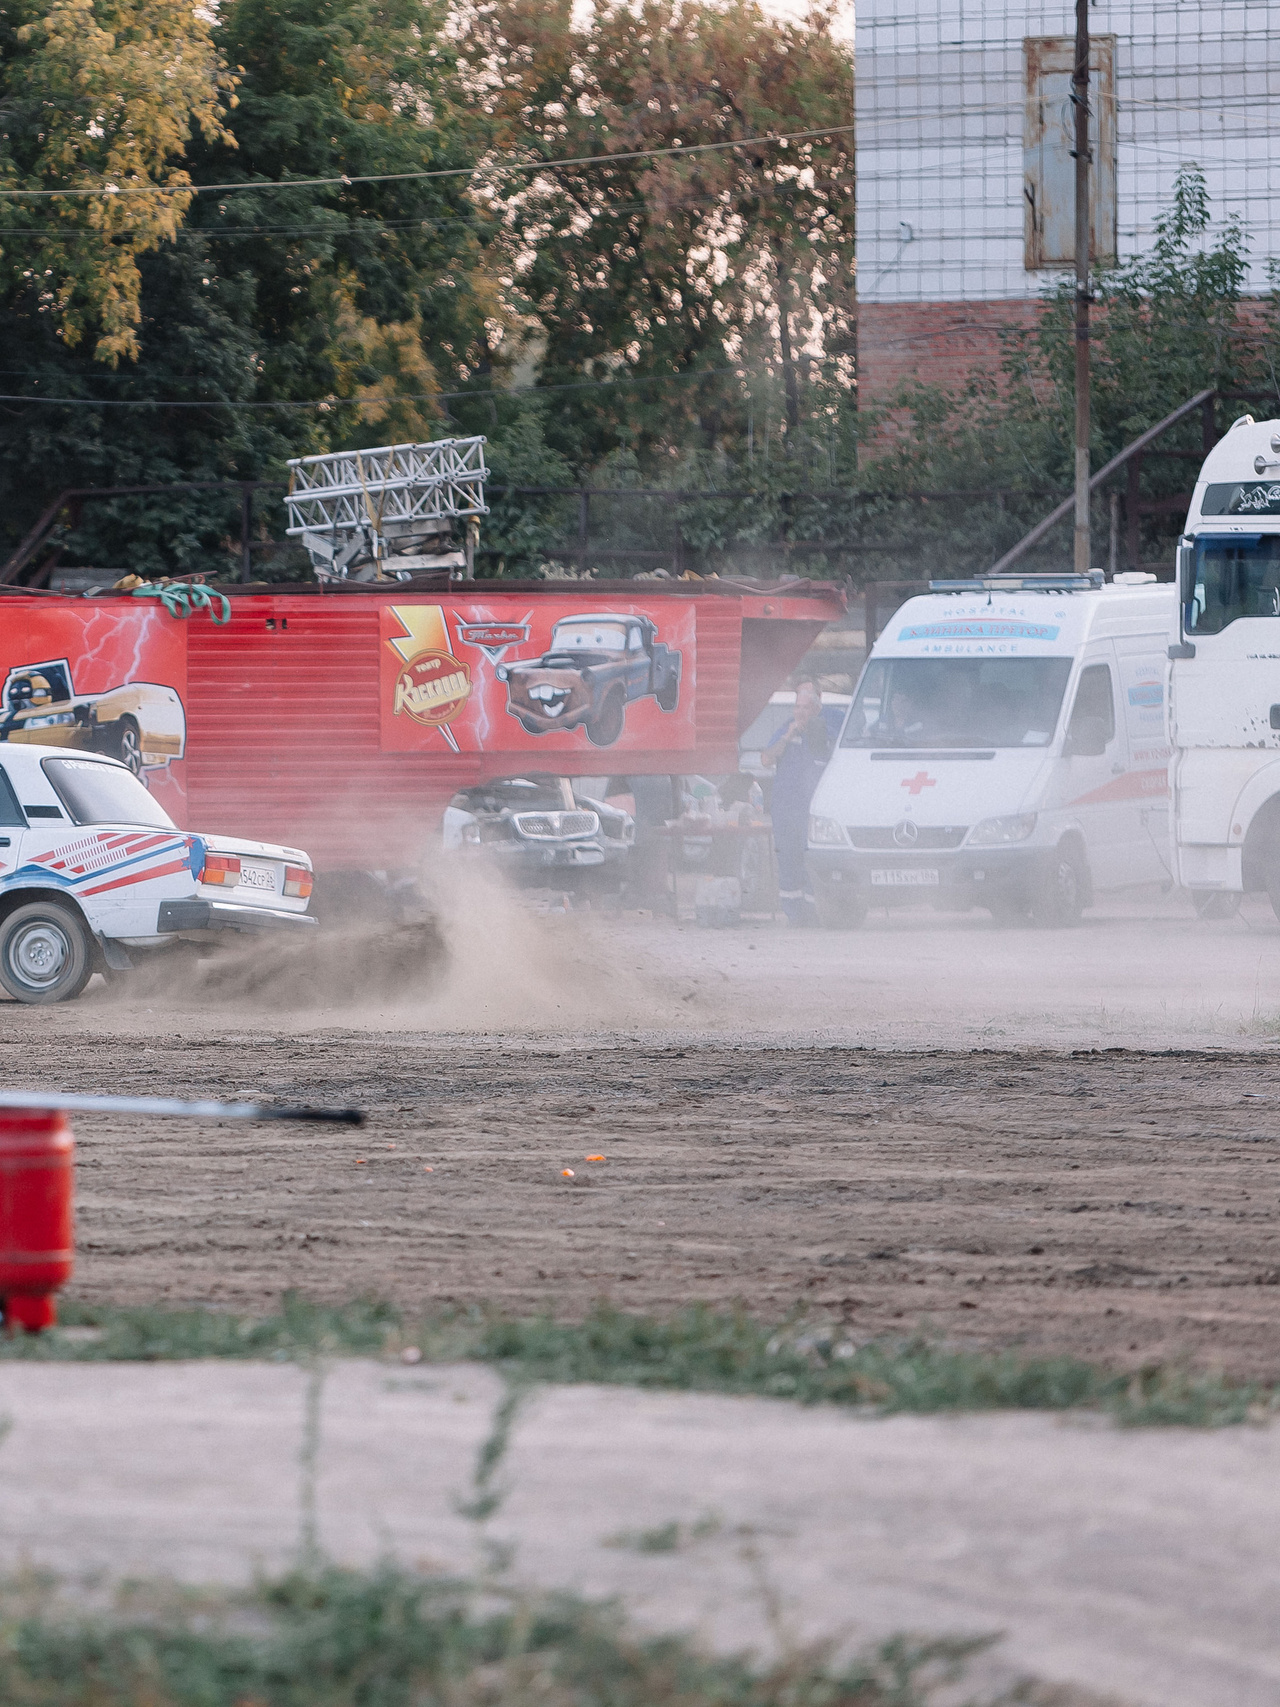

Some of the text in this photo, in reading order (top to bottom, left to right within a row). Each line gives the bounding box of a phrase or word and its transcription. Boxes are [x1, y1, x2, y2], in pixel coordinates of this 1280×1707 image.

[943, 607, 1026, 617] HOSPITAL
[909, 624, 1048, 637] КЛИНИКА ПРЕТОР
[922, 643, 1019, 653] AMBULANCE
